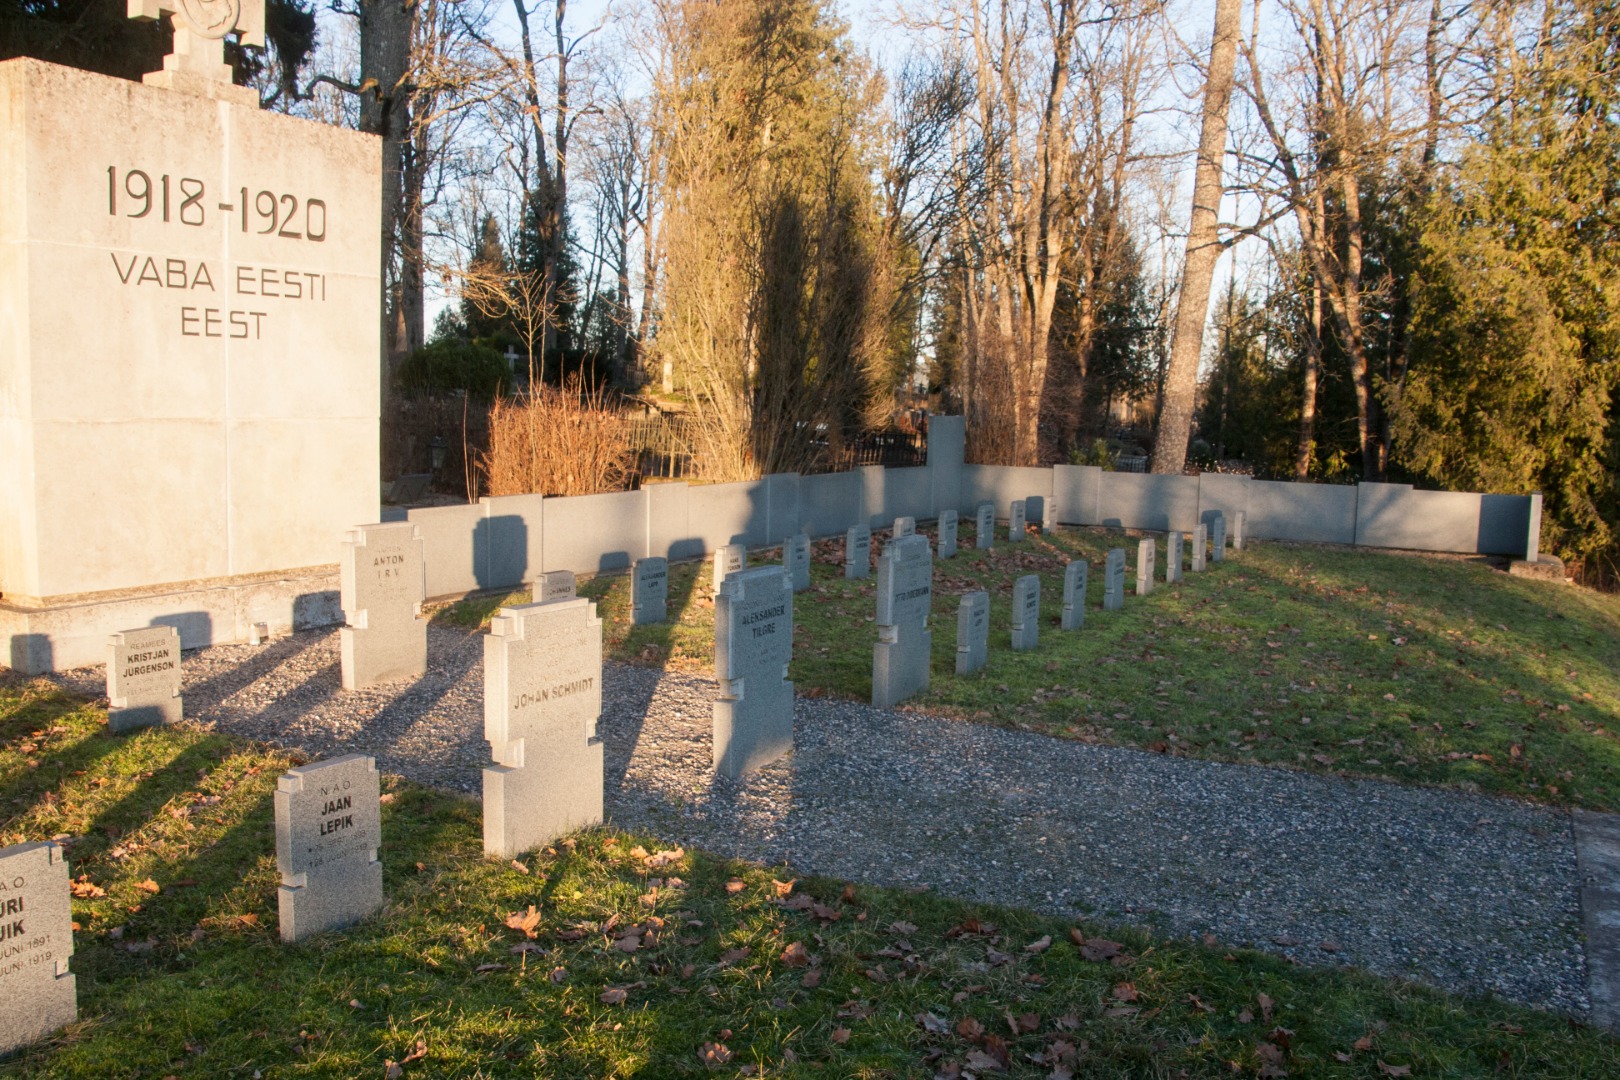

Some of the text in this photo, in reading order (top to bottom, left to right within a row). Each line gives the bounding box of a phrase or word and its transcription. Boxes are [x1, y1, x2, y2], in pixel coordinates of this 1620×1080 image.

[107, 165, 326, 242] 1918-1920
[110, 252, 326, 301] VABA EESTI
[181, 306, 267, 340] EEST
[373, 555, 404, 567] ANTON
[742, 605, 785, 625] ALEKSANDER
[752, 623, 776, 639] TILGRE
[127, 649, 169, 664] KRISTJAN
[514, 688, 549, 710] JOHAN
[552, 677, 594, 699] SCHMIDT
[321, 796, 352, 816] JAAN
[320, 815, 354, 836] LEPIK
